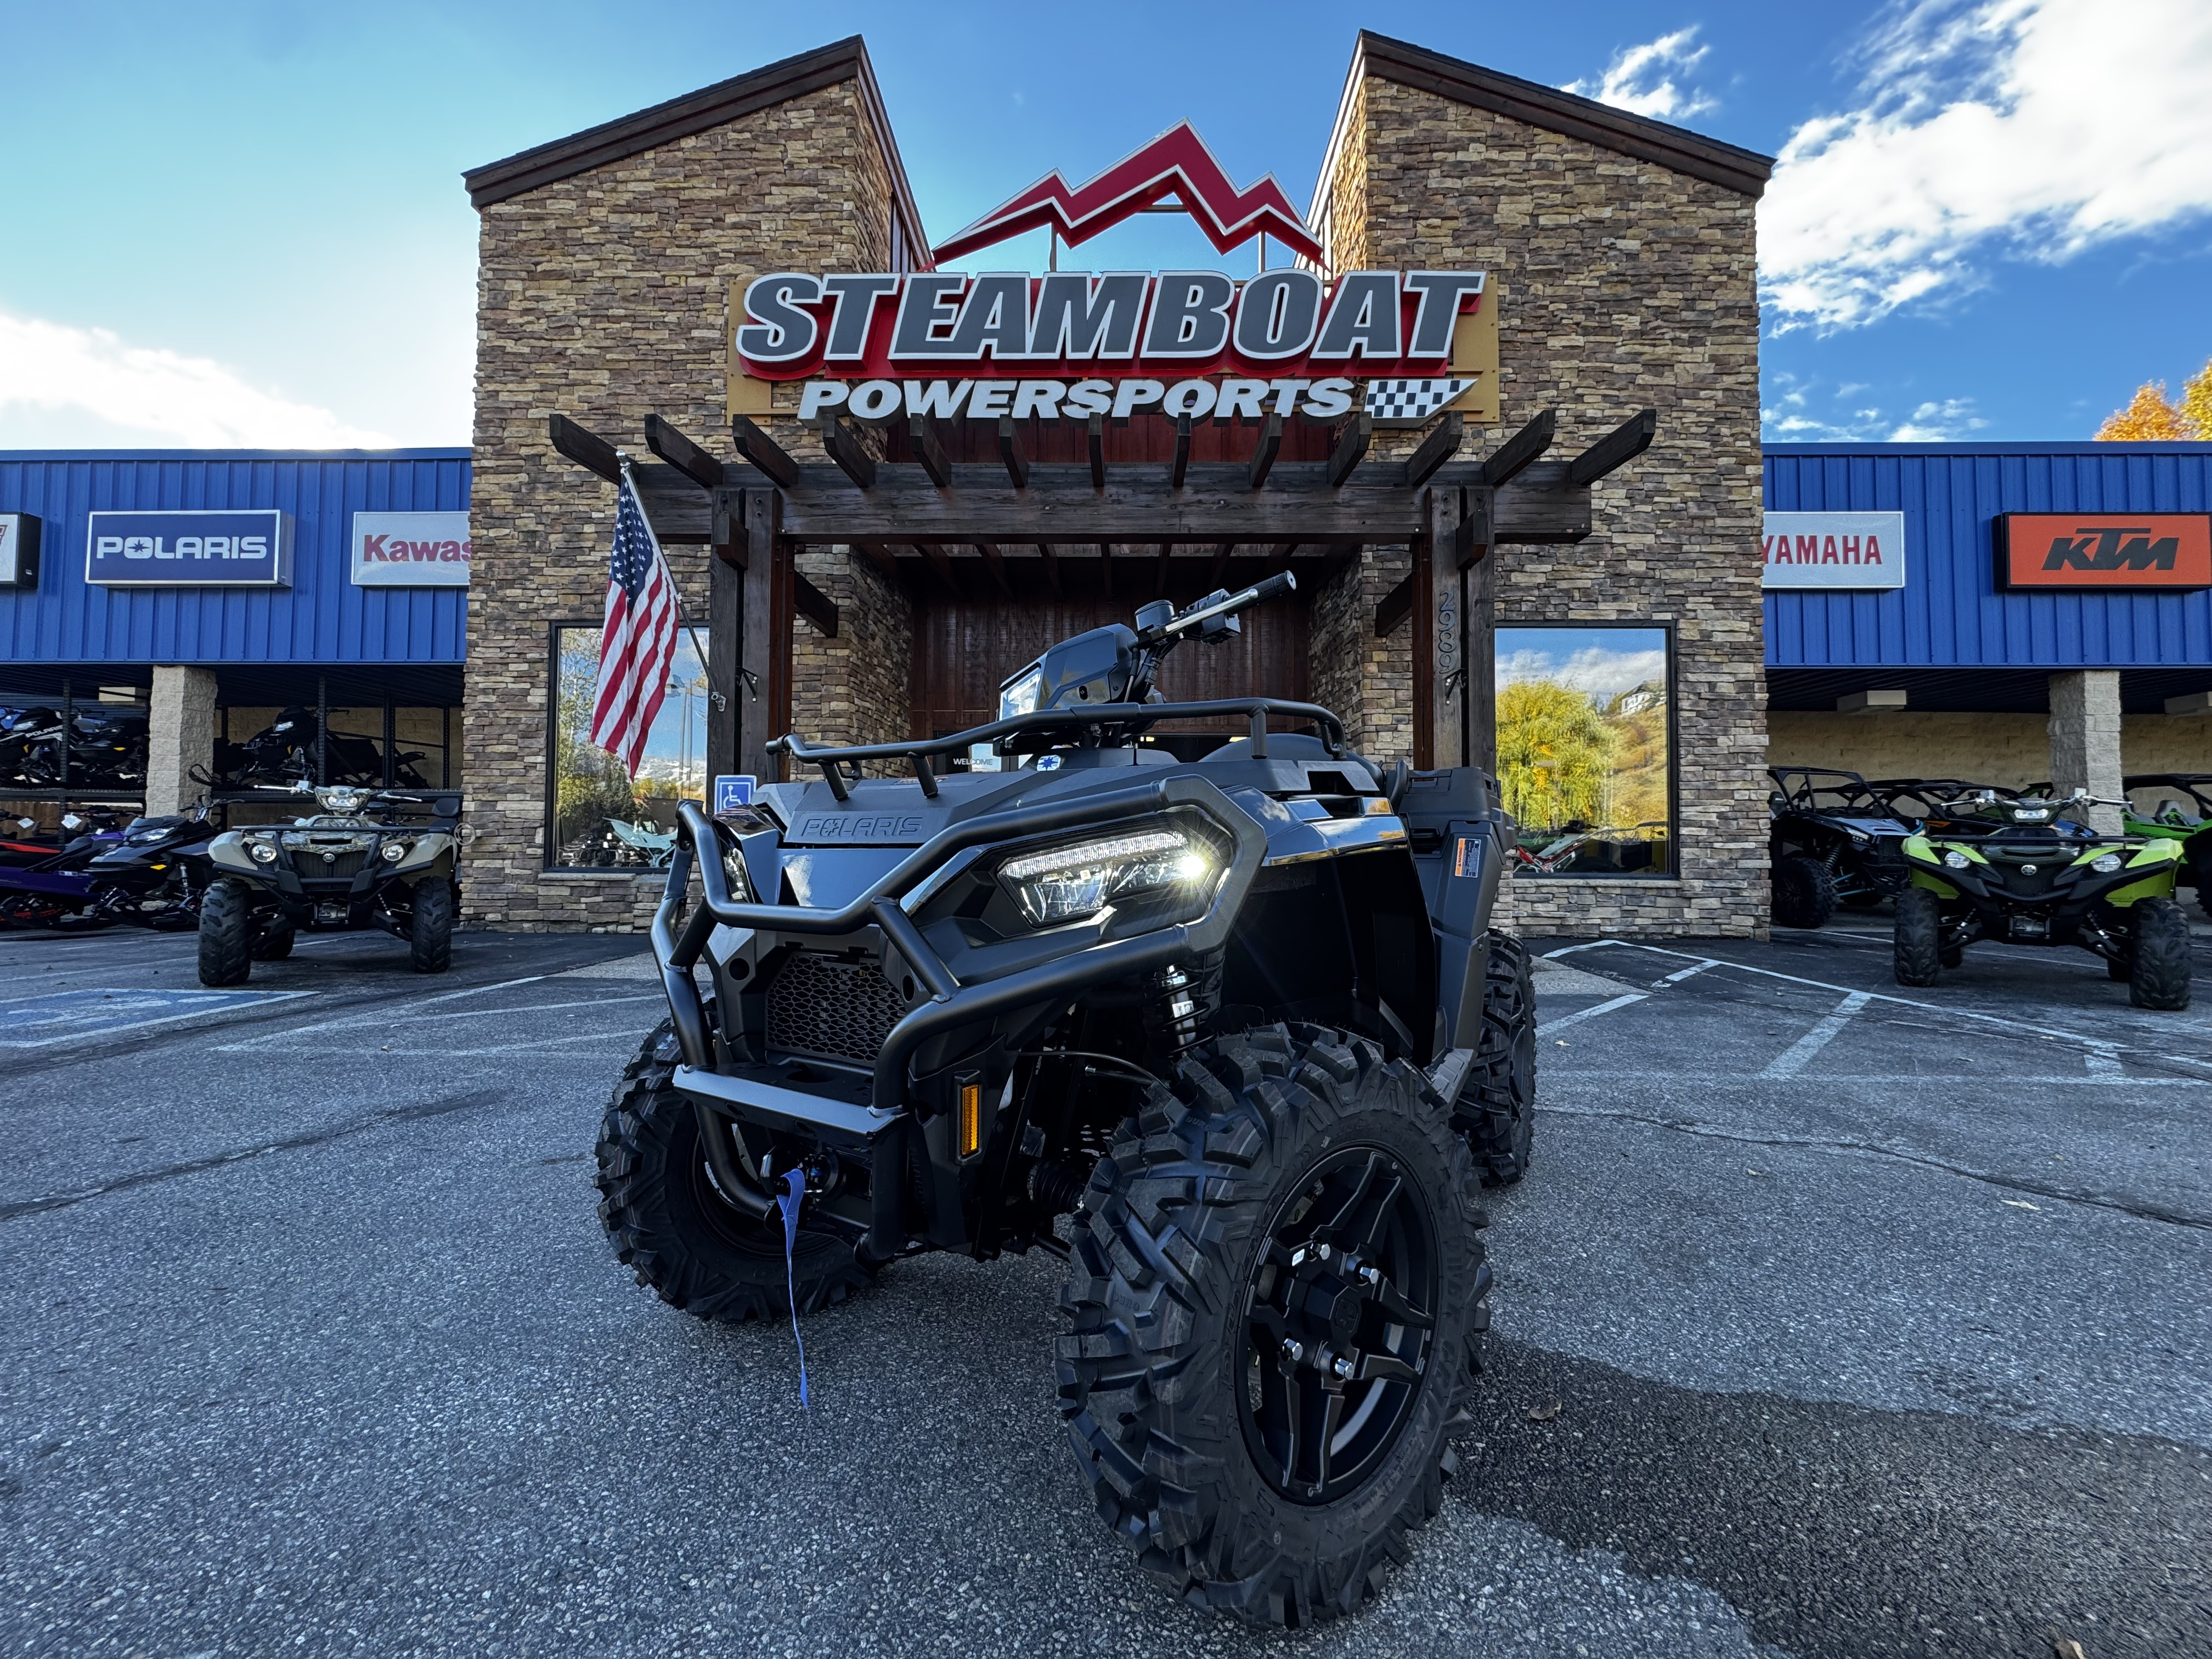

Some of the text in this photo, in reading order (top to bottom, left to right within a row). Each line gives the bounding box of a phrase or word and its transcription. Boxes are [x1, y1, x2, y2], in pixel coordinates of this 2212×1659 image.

[736, 270, 1486, 363] STEAMBOAT
[797, 379, 1353, 421] POWERSPORTS
[97, 536, 267, 559] POLARIS
[1763, 535, 1883, 565] YAMAHA
[2041, 527, 2180, 570] KTM
[1438, 589, 1456, 674] 2989
[953, 758, 993, 766] WELCOME
[800, 816, 923, 837] POLARIS
[1113, 1291, 1140, 1312] DURO
